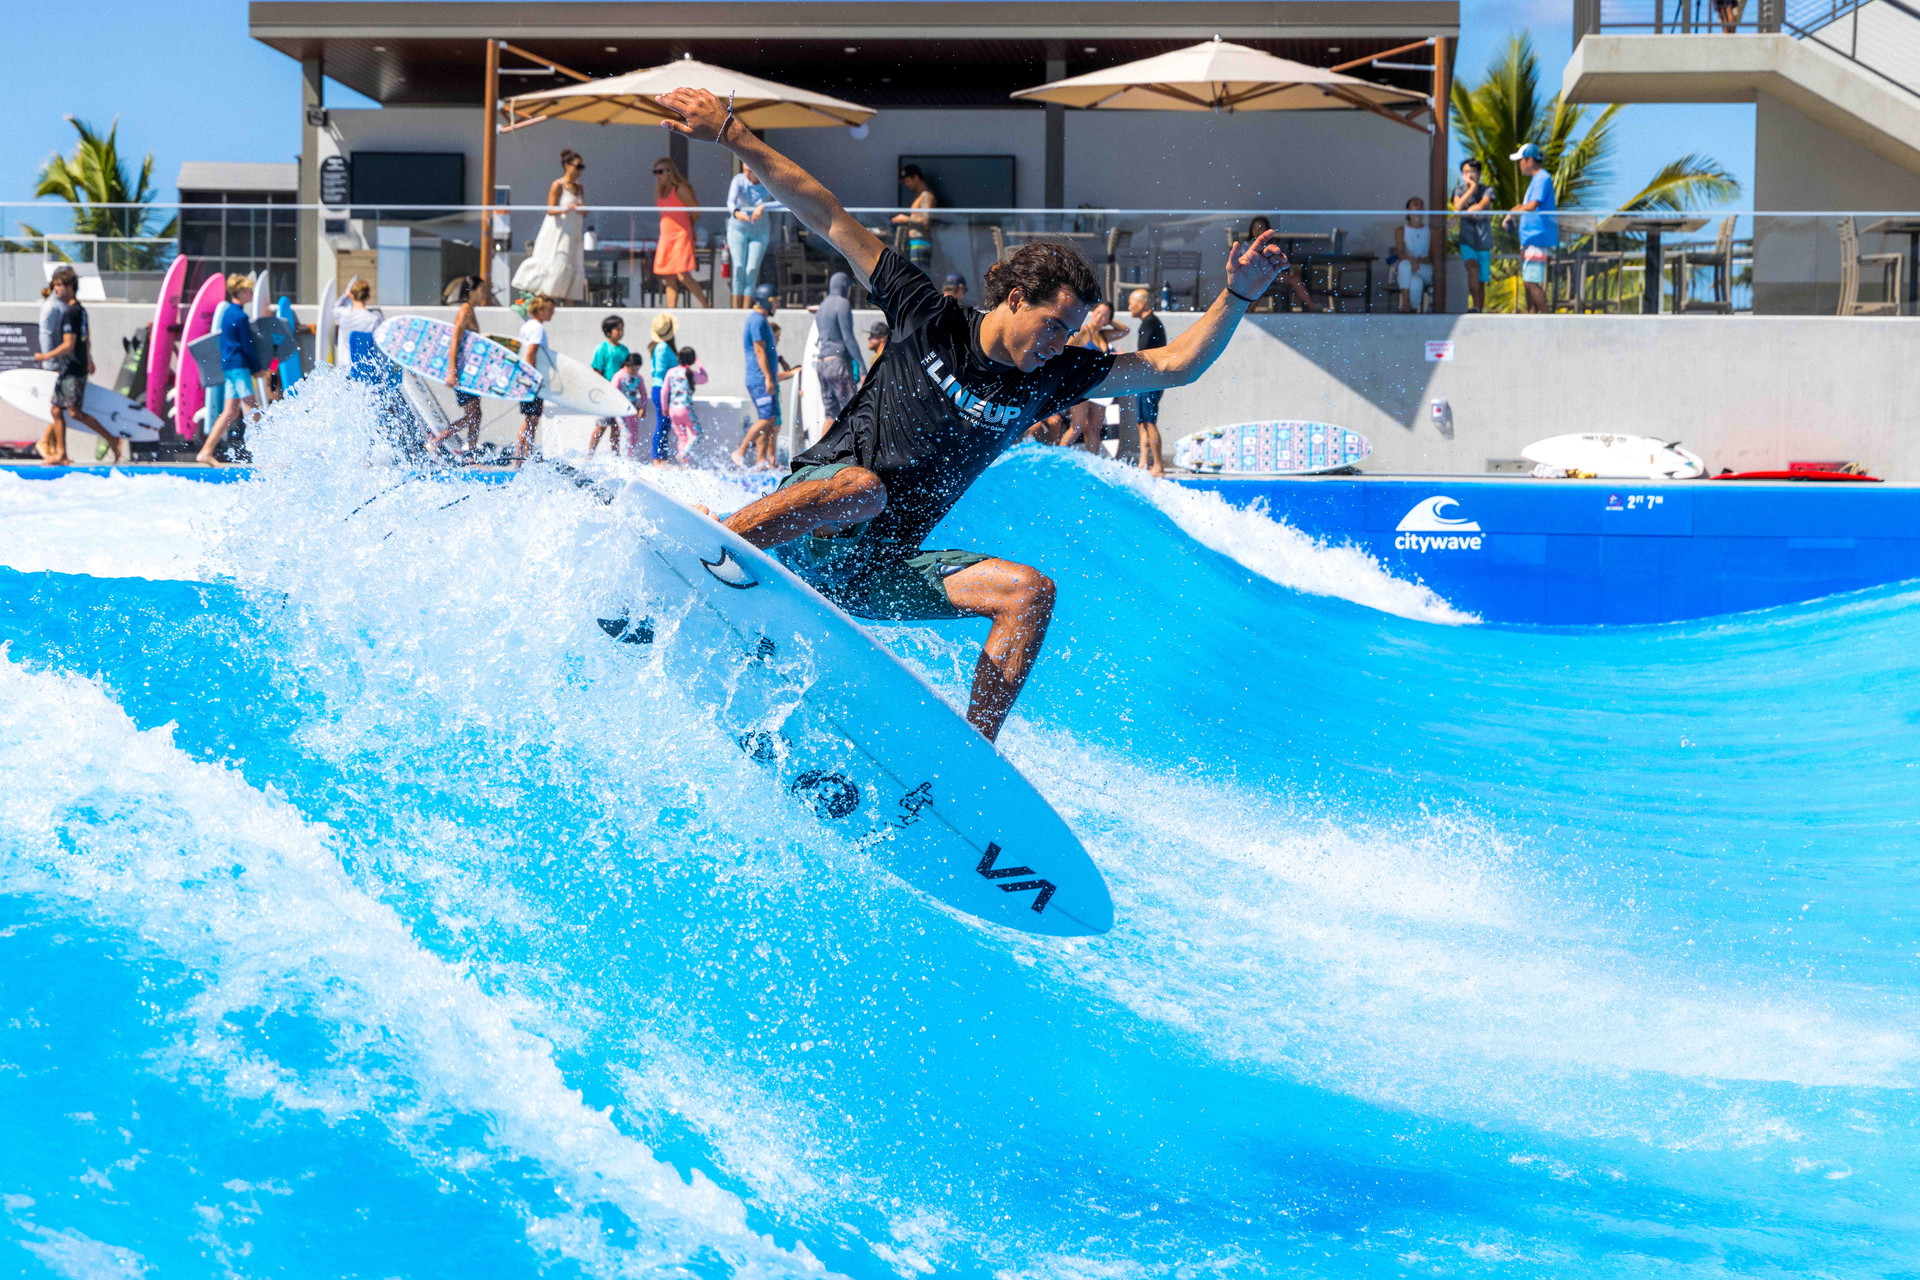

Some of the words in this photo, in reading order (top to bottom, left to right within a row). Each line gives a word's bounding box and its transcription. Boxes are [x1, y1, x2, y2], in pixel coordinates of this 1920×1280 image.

[920, 351, 937, 366] THE
[926, 358, 1021, 425] LINEUP
[958, 412, 970, 421] WAI
[1394, 532, 1482, 554] citywave
